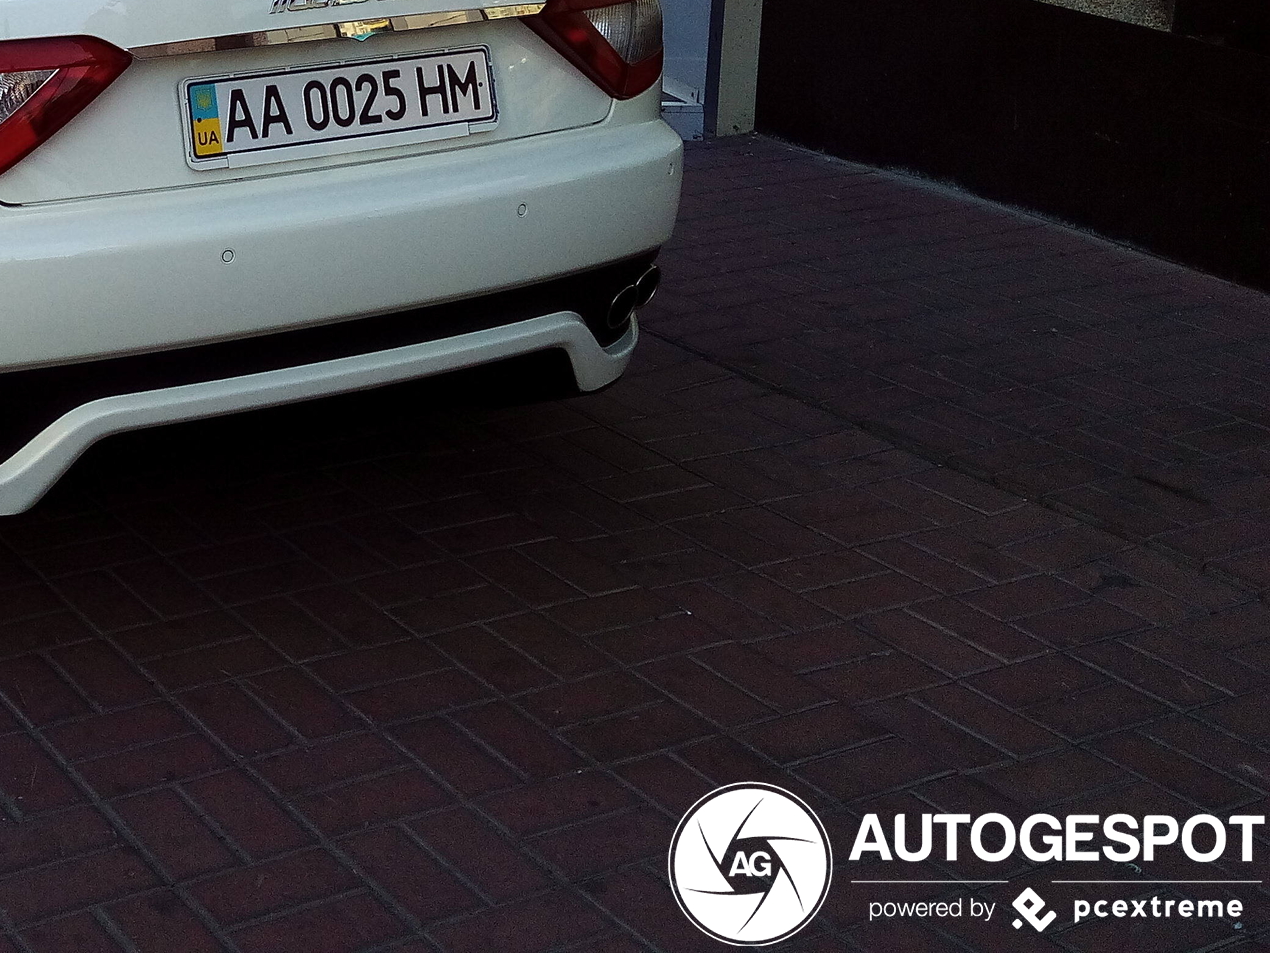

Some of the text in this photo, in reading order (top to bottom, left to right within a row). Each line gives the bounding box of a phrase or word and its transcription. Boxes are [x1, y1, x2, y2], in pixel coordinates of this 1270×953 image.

[226, 60, 482, 143] AA 0025 HM
[197, 131, 220, 147] UA
